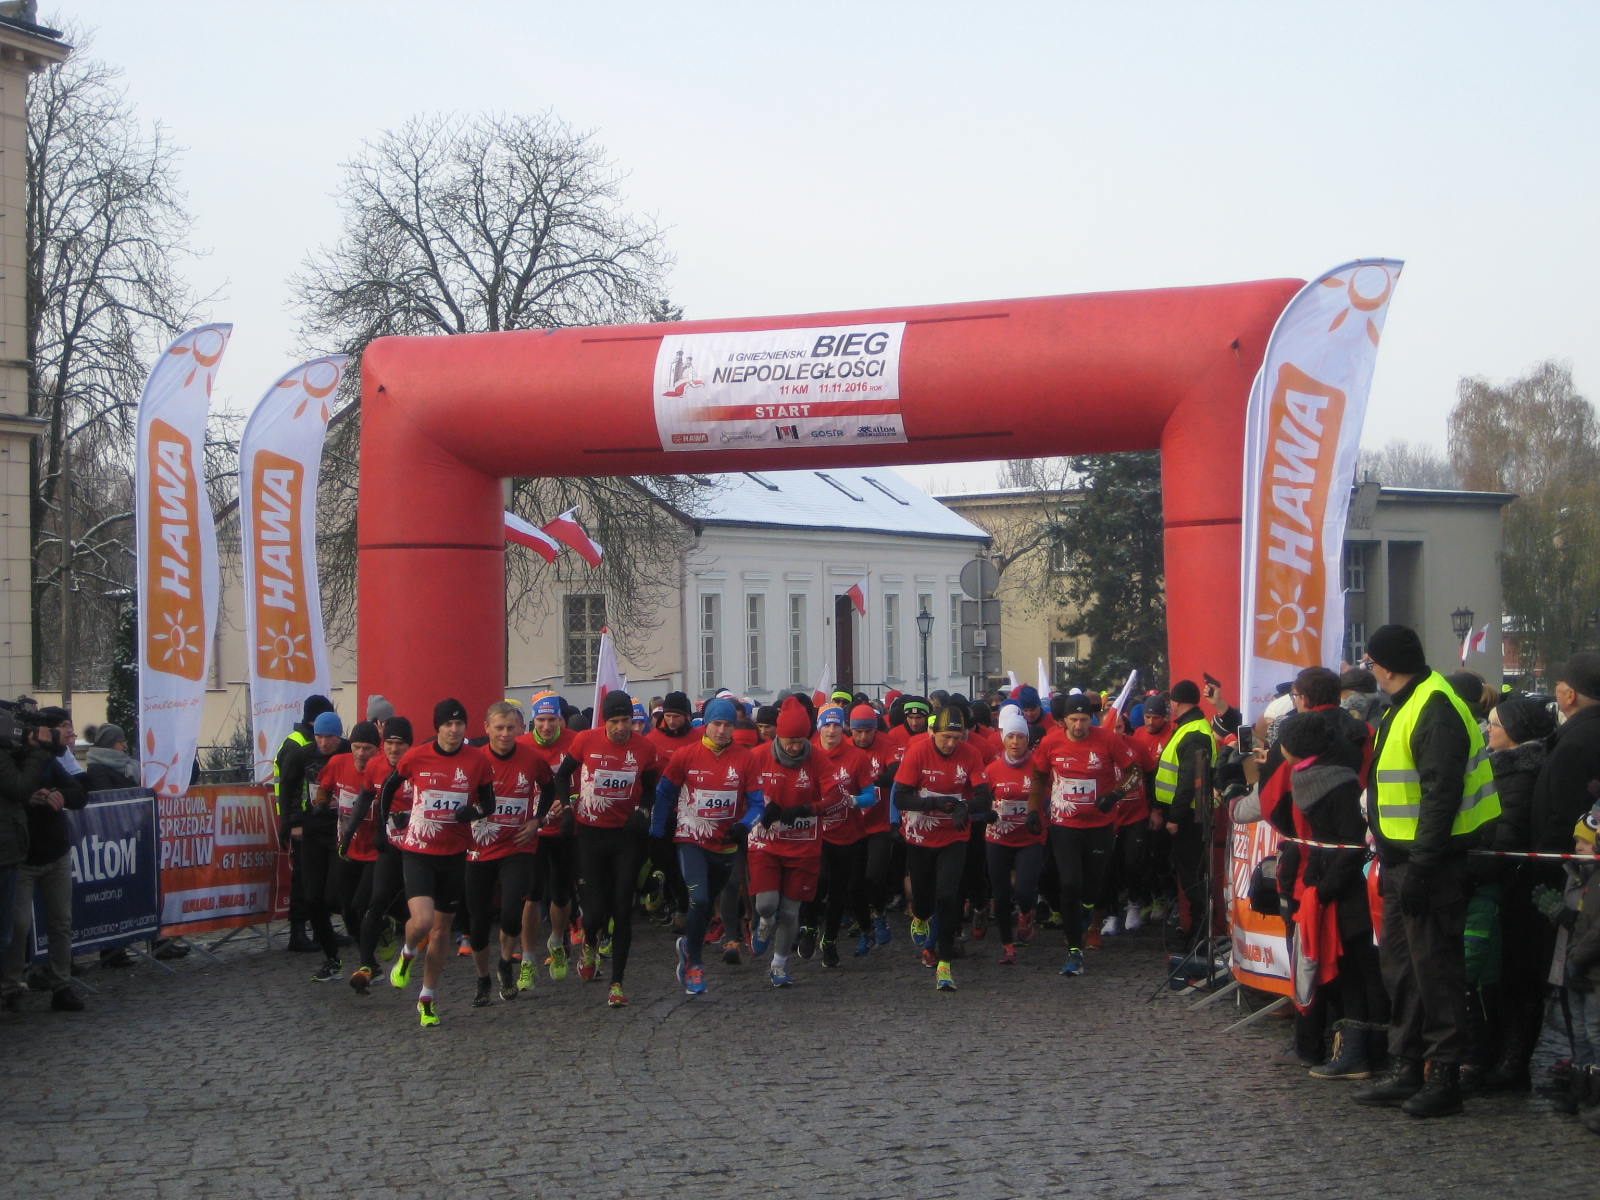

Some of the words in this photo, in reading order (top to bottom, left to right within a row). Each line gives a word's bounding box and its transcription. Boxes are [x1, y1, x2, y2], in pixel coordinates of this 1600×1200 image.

[810, 332, 890, 358] BIEG
[712, 357, 885, 384] NIEPODLEGŁOŚCI
[779, 385, 790, 395] 11
[791, 384, 809, 394] KM
[818, 381, 868, 393] 11.11.2016
[755, 404, 810, 418] START
[1267, 387, 1329, 576] HAWA
[156, 439, 191, 600] HAWA
[260, 467, 295, 613] HAWA
[602, 779, 628, 789] 480
[1072, 786, 1085, 795] 11
[432, 799, 460, 811] 417
[496, 805, 521, 815] 187
[705, 798, 731, 809] 494
[160, 811, 213, 838] SPRZEDAŻ
[221, 805, 266, 836] HAWA
[160, 836, 213, 869] PALIW
[222, 853, 235, 869] 61
